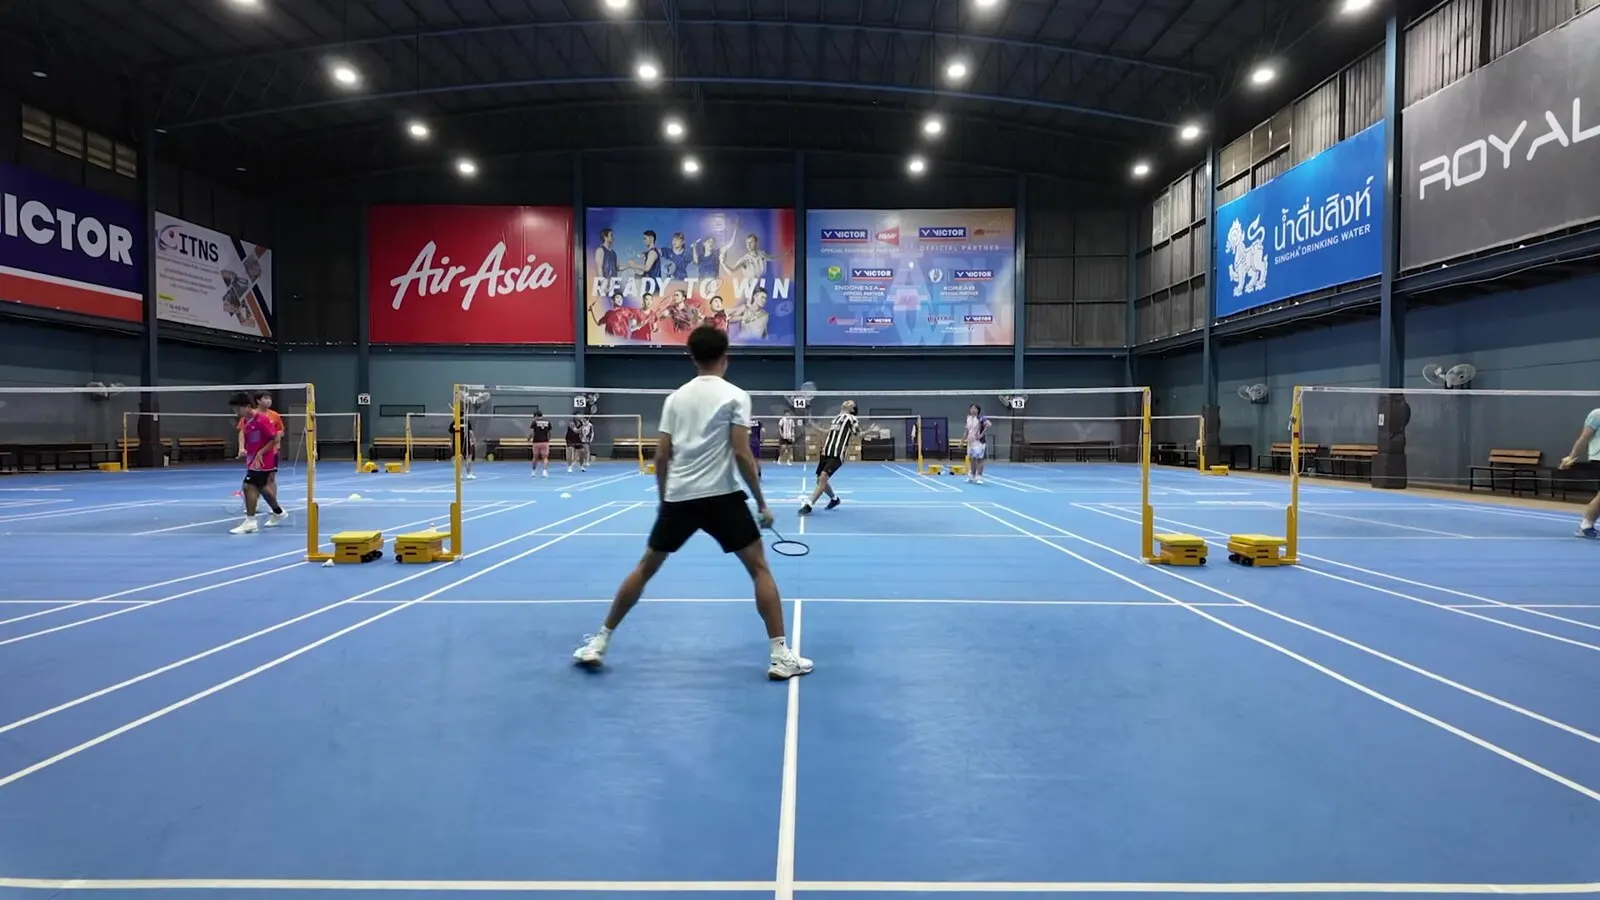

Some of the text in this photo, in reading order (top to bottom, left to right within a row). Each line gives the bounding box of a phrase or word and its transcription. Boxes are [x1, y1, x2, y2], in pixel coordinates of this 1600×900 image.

[1419, 97, 1600, 200] ROYAL
[0, 191, 133, 266] ICTOR
[932, 229, 964, 237] VICTOR
[1274, 175, 1374, 251] น้ำดื่มสิงห์
[179, 232, 219, 263] ITNS
[1274, 223, 1371, 265] SINGHA DRINKING WATER
[592, 276, 671, 297] READY
[684, 277, 717, 299] TO
